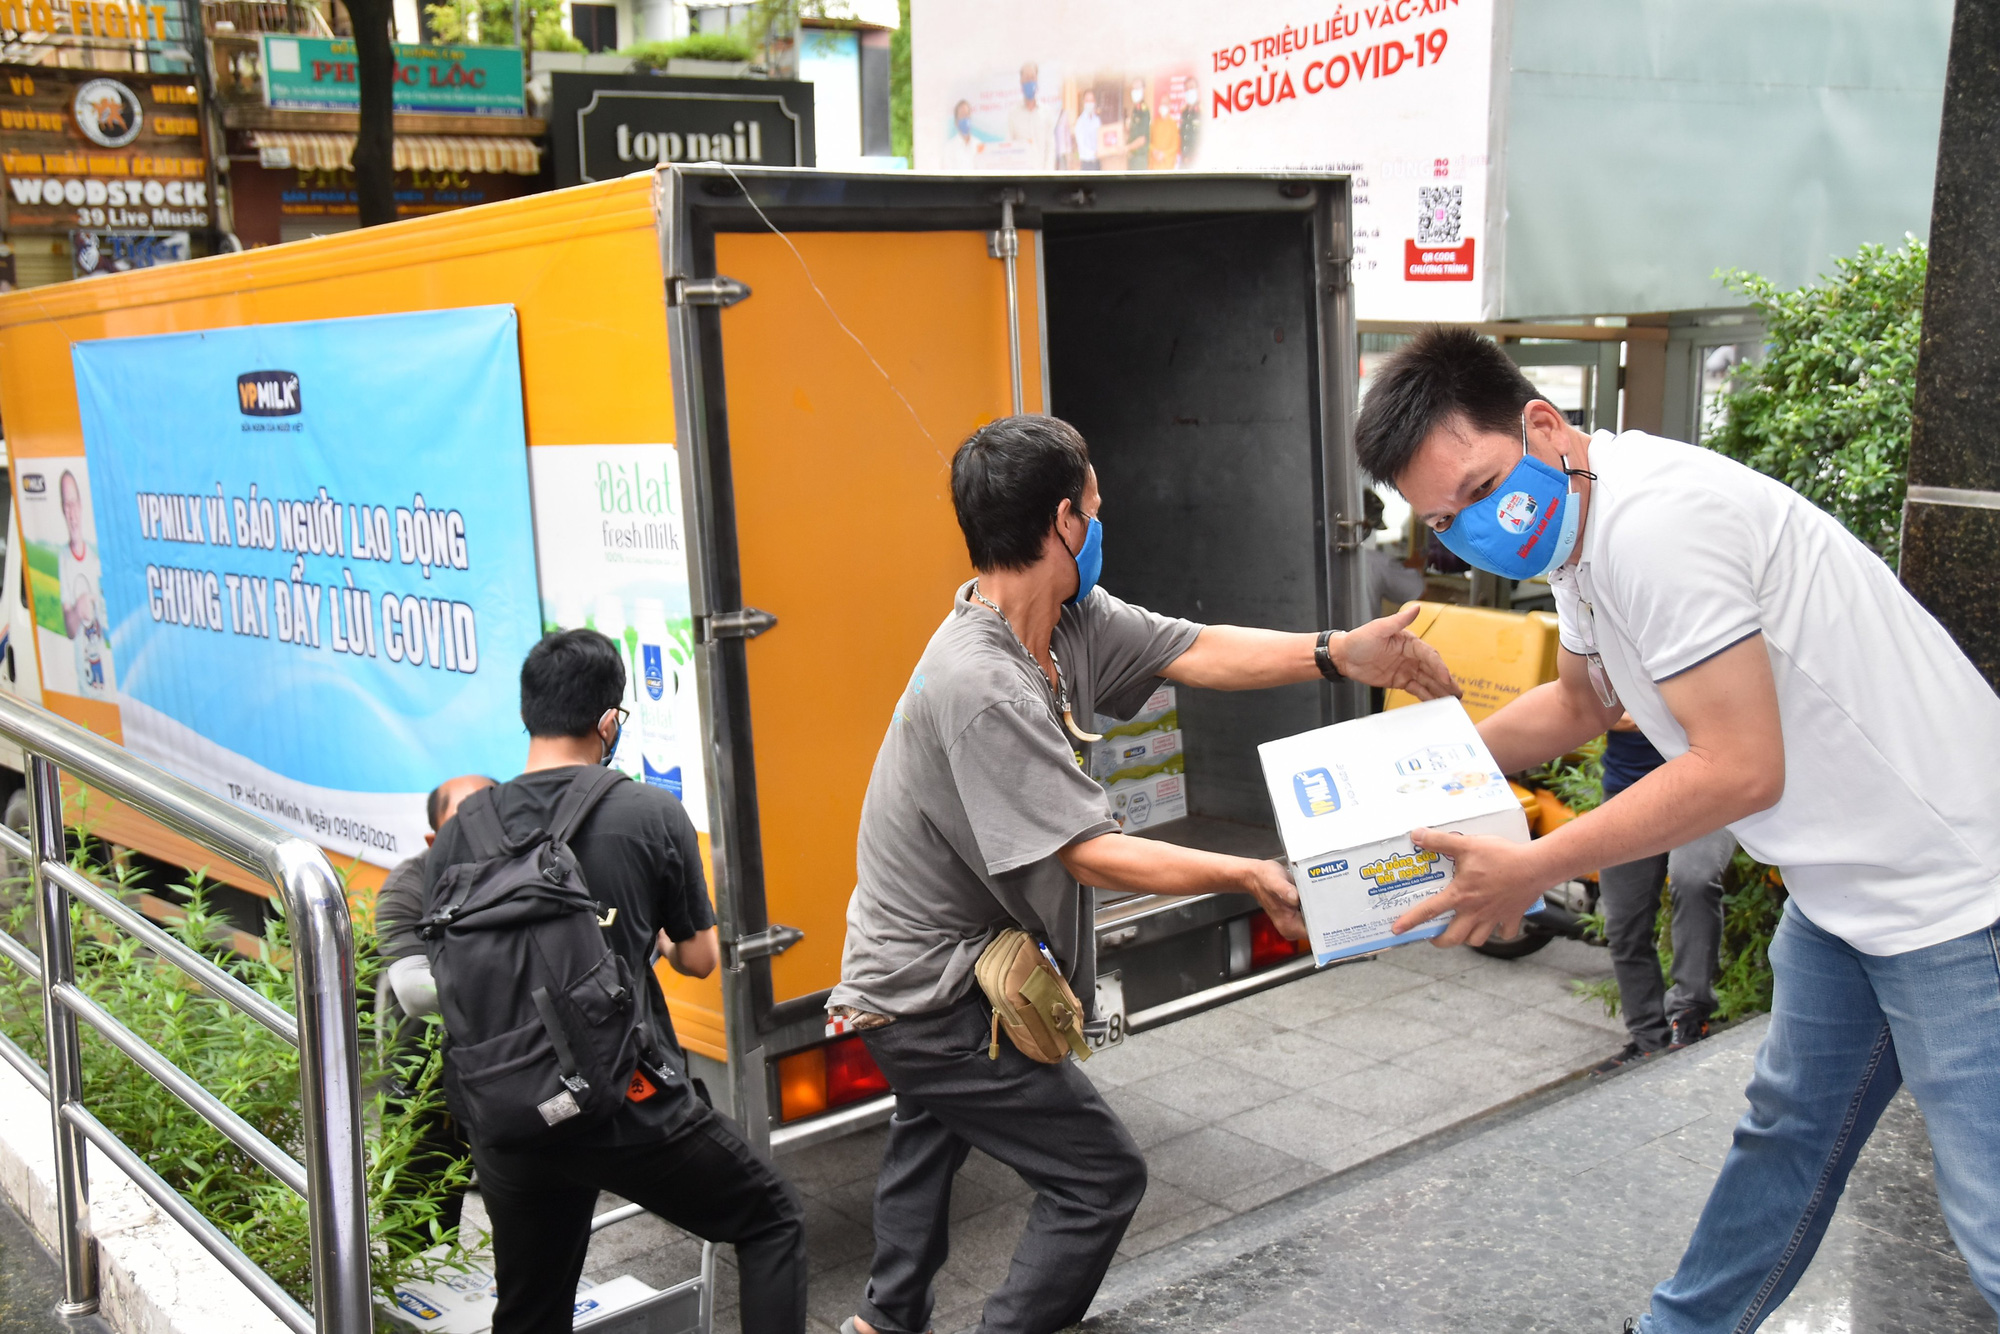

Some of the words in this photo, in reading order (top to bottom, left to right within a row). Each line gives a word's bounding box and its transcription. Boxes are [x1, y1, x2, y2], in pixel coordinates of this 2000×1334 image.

[70, 1, 167, 41] FIGHT
[1212, 45, 1247, 73] 150
[1250, 24, 1308, 61] TRIỆU
[1212, 64, 1296, 118] NGỪA
[1303, 28, 1448, 94] COVID-19
[616, 123, 682, 163] top
[686, 121, 762, 162] nail
[10, 178, 208, 206] WOODSTOCK
[77, 207, 105, 227] 39
[108, 208, 149, 226] Live
[152, 208, 208, 226] Music
[1434, 252, 1455, 262] CODE
[239, 377, 297, 410] VPMILK
[137, 492, 205, 544] VPMILK
[206, 482, 231, 546] VÀ
[233, 483, 275, 550] BÁO
[278, 487, 344, 557] NGƯỜI
[350, 504, 392, 563] LAO
[396, 493, 469, 579] ĐỘNG
[146, 564, 223, 631] CHUNG
[224, 573, 269, 638] TAY
[274, 555, 320, 648] ĐẨY
[329, 568, 376, 657] LÙI
[381, 593, 478, 674] COVID
[259, 793, 274, 814] Chí
[276, 797, 304, 825] Minh,
[305, 807, 332, 836] Ngày
[334, 816, 398, 853] 09/06/2021
[1310, 860, 1346, 877] VPMILK
